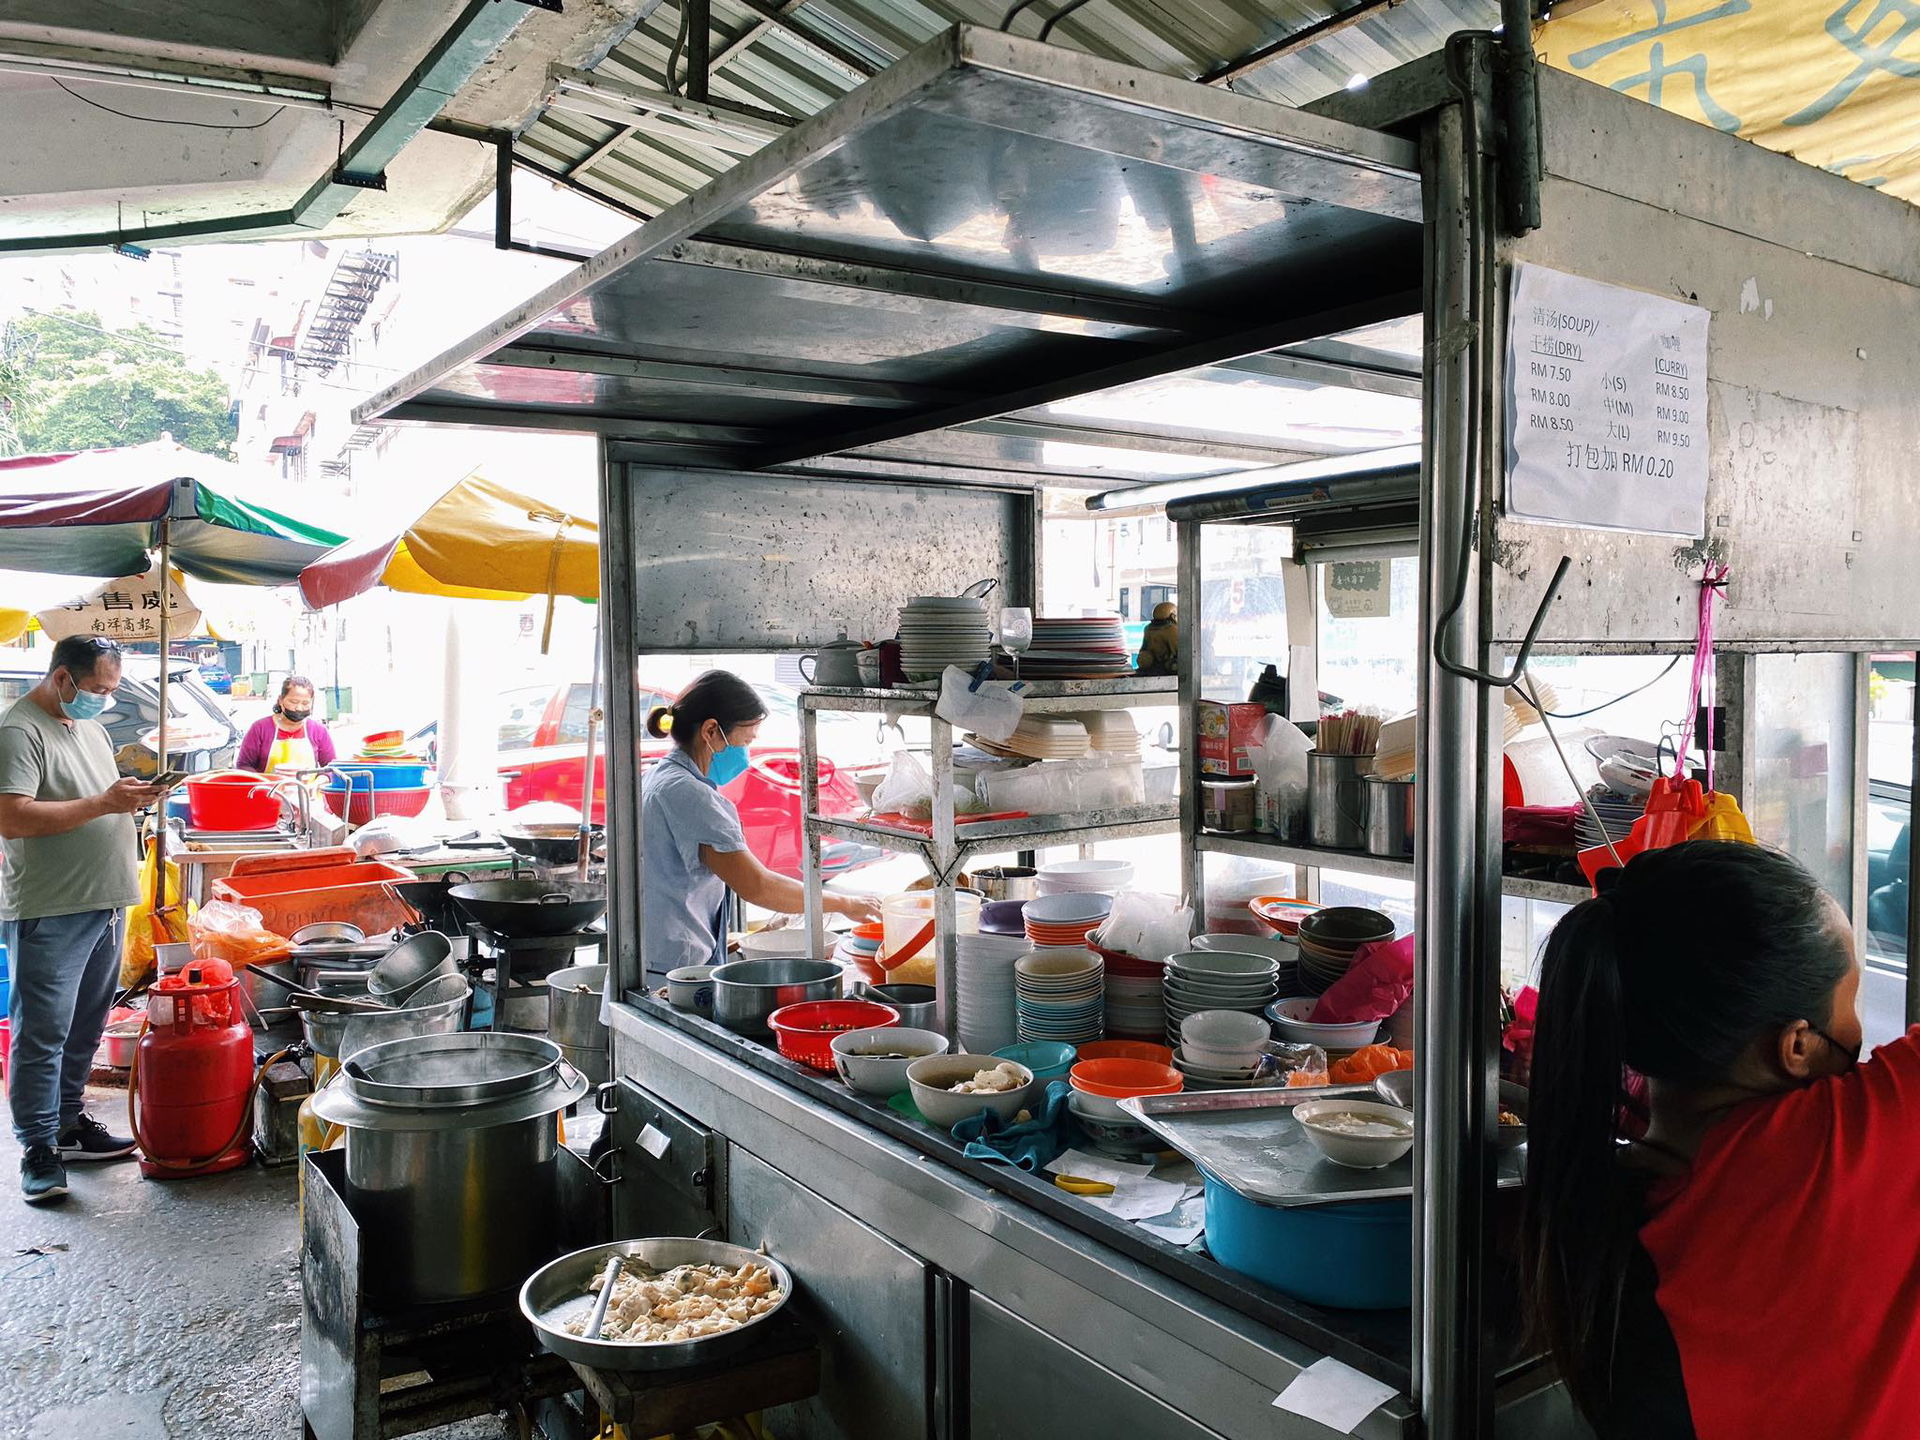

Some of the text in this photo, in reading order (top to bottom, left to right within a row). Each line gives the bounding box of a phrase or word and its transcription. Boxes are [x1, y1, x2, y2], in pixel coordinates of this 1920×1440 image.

[1530, 361, 1571, 382] RM 7.50
[1655, 357, 1688, 379] (CURRY)
[1600, 371, 1627, 393] 小(S)
[1655, 382, 1690, 401] RM 8.50
[1530, 387, 1571, 408] RM 8.00
[1603, 396, 1634, 417] 中(M)
[1530, 414, 1574, 432] RM 8.50
[1656, 406, 1689, 424] RM 9.00
[1605, 420, 1630, 441] 大(L)
[1657, 430, 1690, 448] RM 9.50
[1566, 441, 1674, 478] 打包加 RM 0.20
[91, 617, 154, 632] 南洋商報
